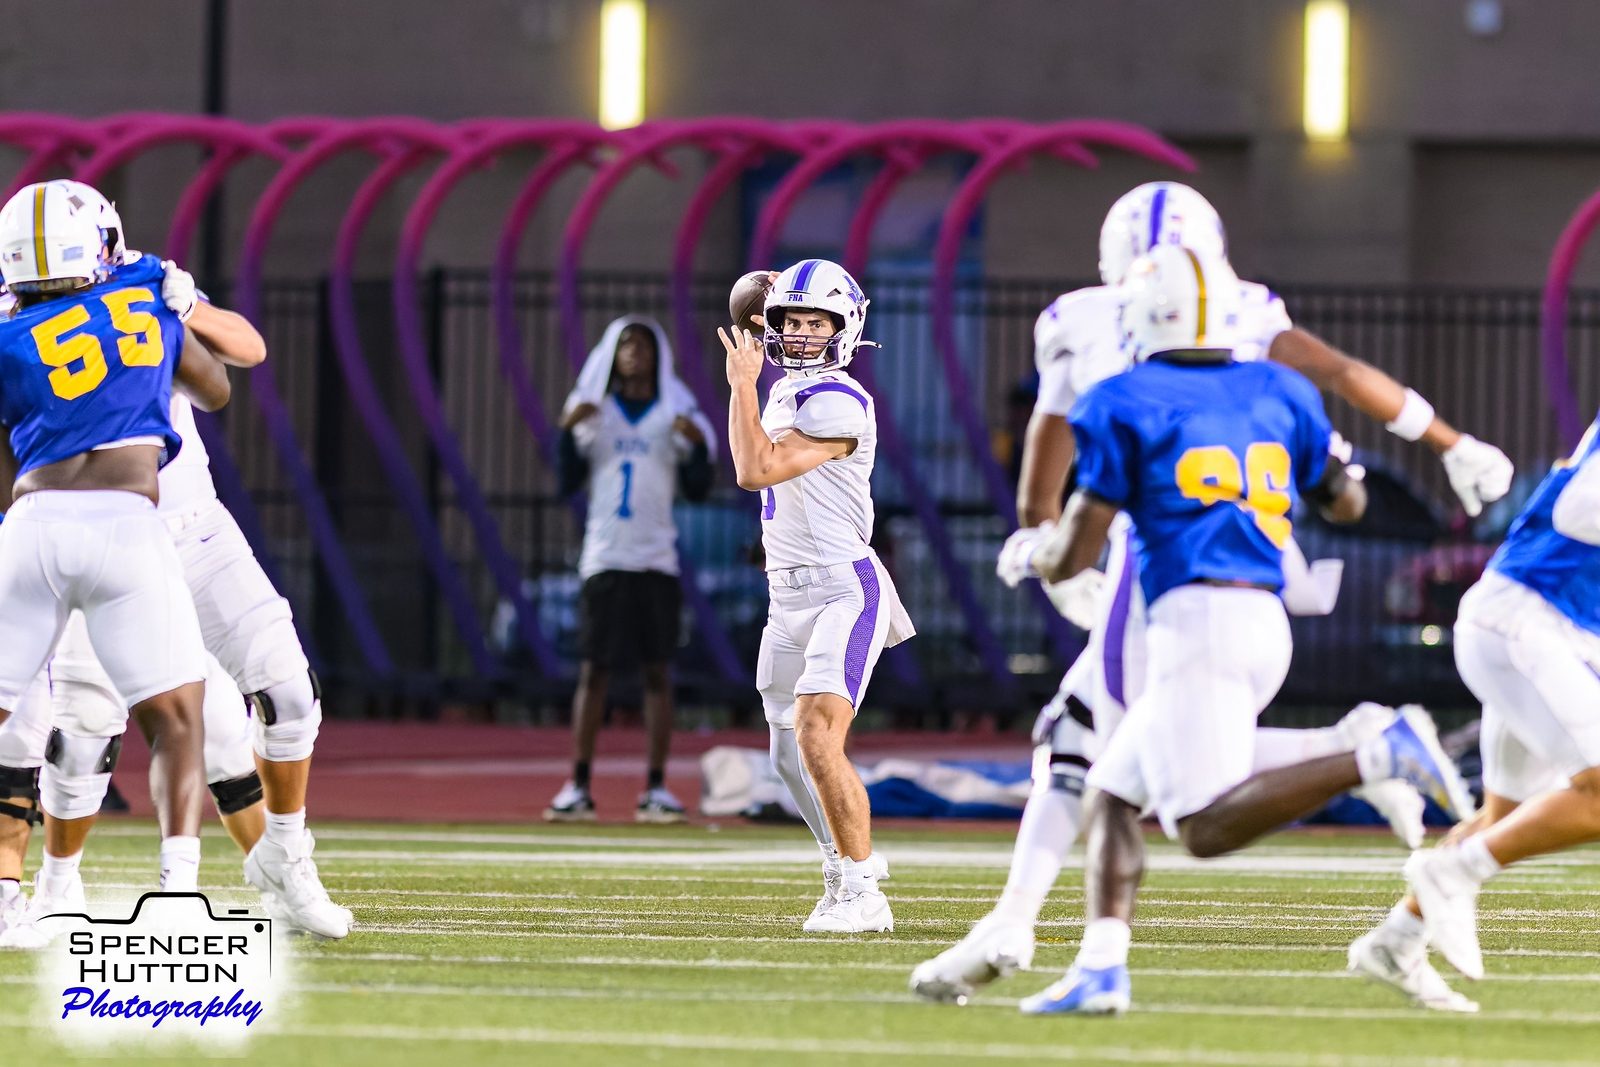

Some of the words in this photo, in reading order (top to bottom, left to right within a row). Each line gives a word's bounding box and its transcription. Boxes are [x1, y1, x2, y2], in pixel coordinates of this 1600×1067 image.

[788, 293, 803, 302] FNA
[31, 287, 164, 400] 55
[617, 460, 633, 519] 1
